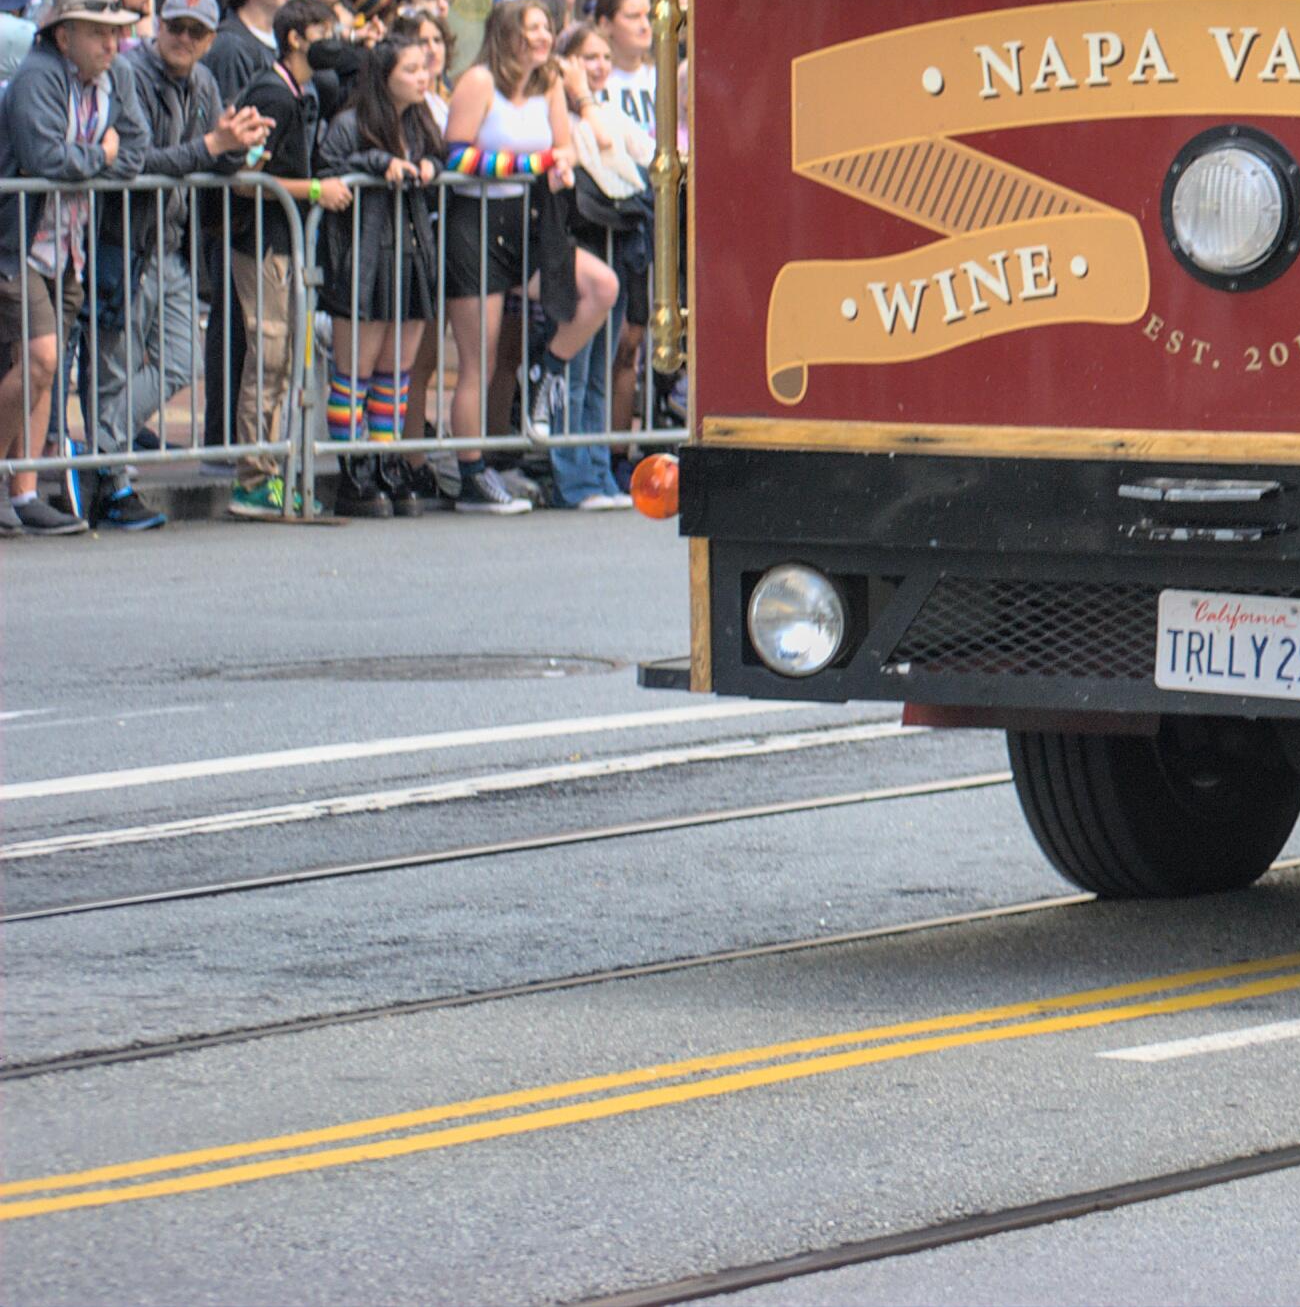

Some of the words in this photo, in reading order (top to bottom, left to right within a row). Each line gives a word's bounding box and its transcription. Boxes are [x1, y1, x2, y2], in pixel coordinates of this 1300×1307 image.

[974, 28, 1176, 98] NAPA
[868, 244, 1058, 334] WINE
[1141, 312, 1222, 371] EST.
[1195, 601, 1297, 631] California
